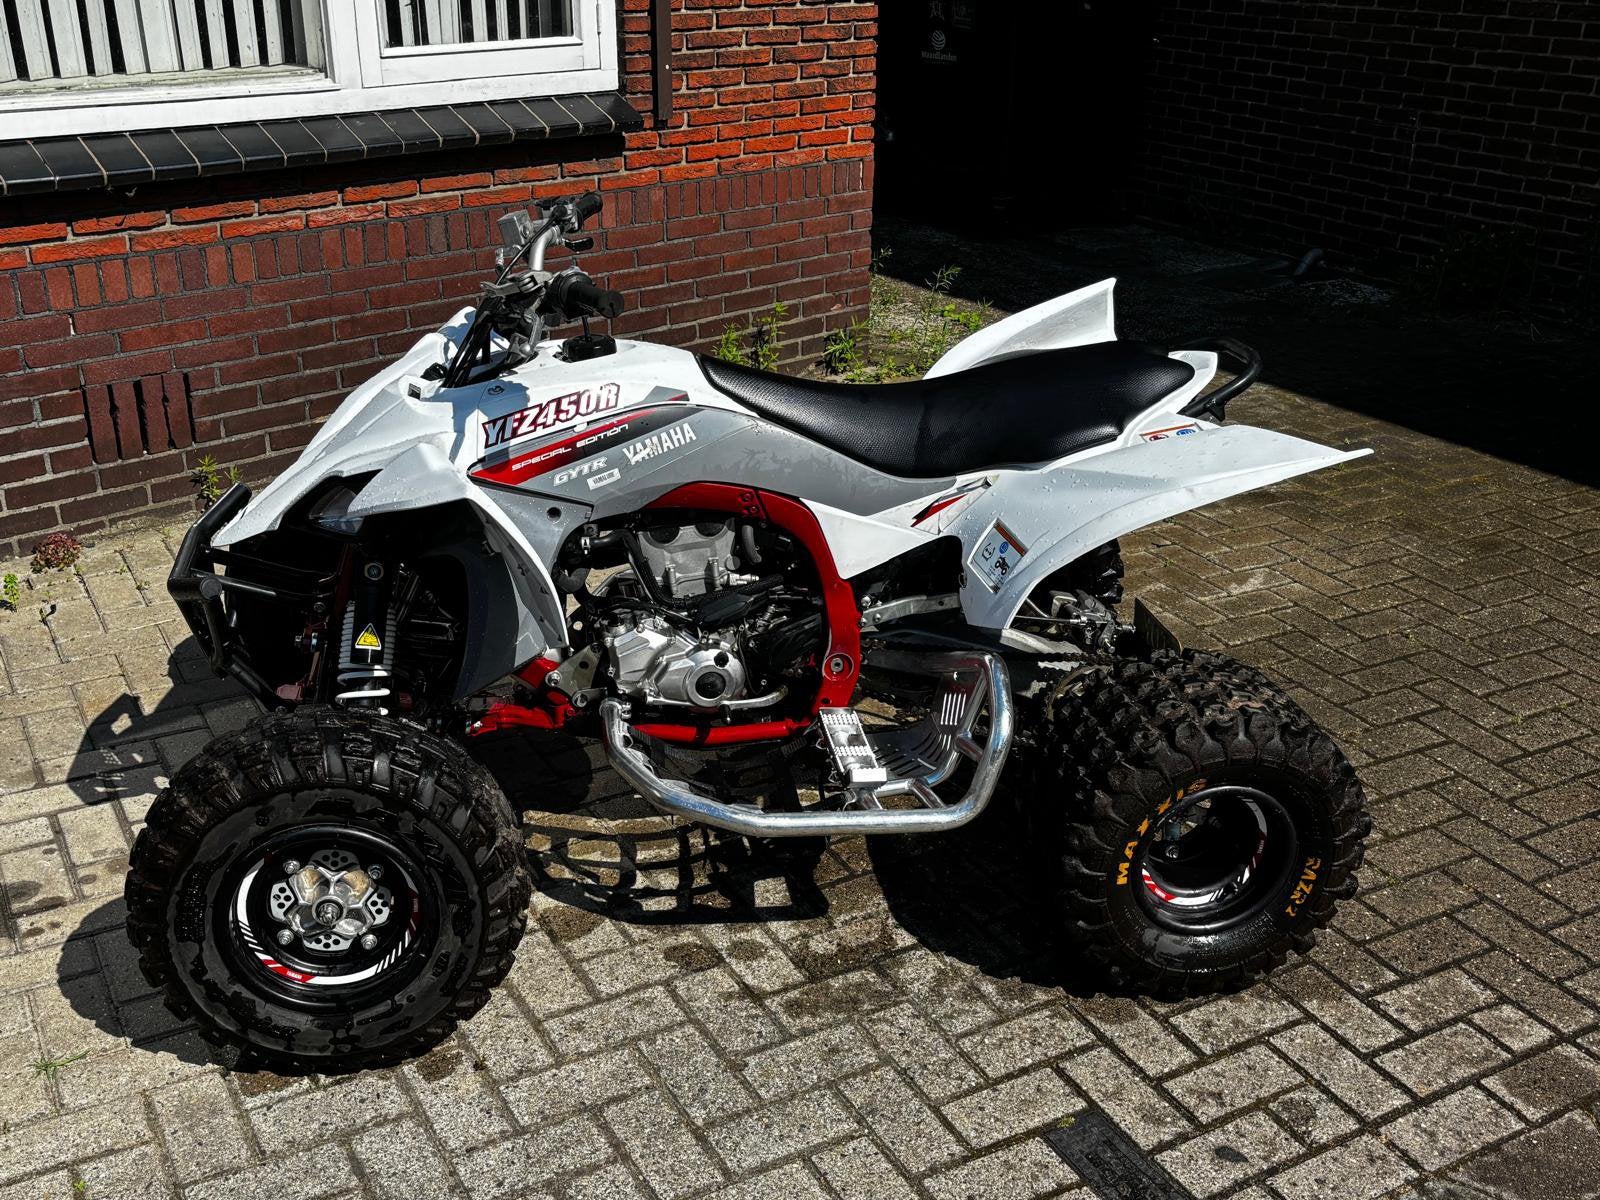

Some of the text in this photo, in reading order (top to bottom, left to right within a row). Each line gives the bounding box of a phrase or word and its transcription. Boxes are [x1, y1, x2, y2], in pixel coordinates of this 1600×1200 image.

[482, 382, 621, 448] YFZ450R
[511, 423, 629, 471] SPECIAL EDITION
[622, 422, 697, 466] YAMAHA
[553, 456, 608, 486] GYTR
